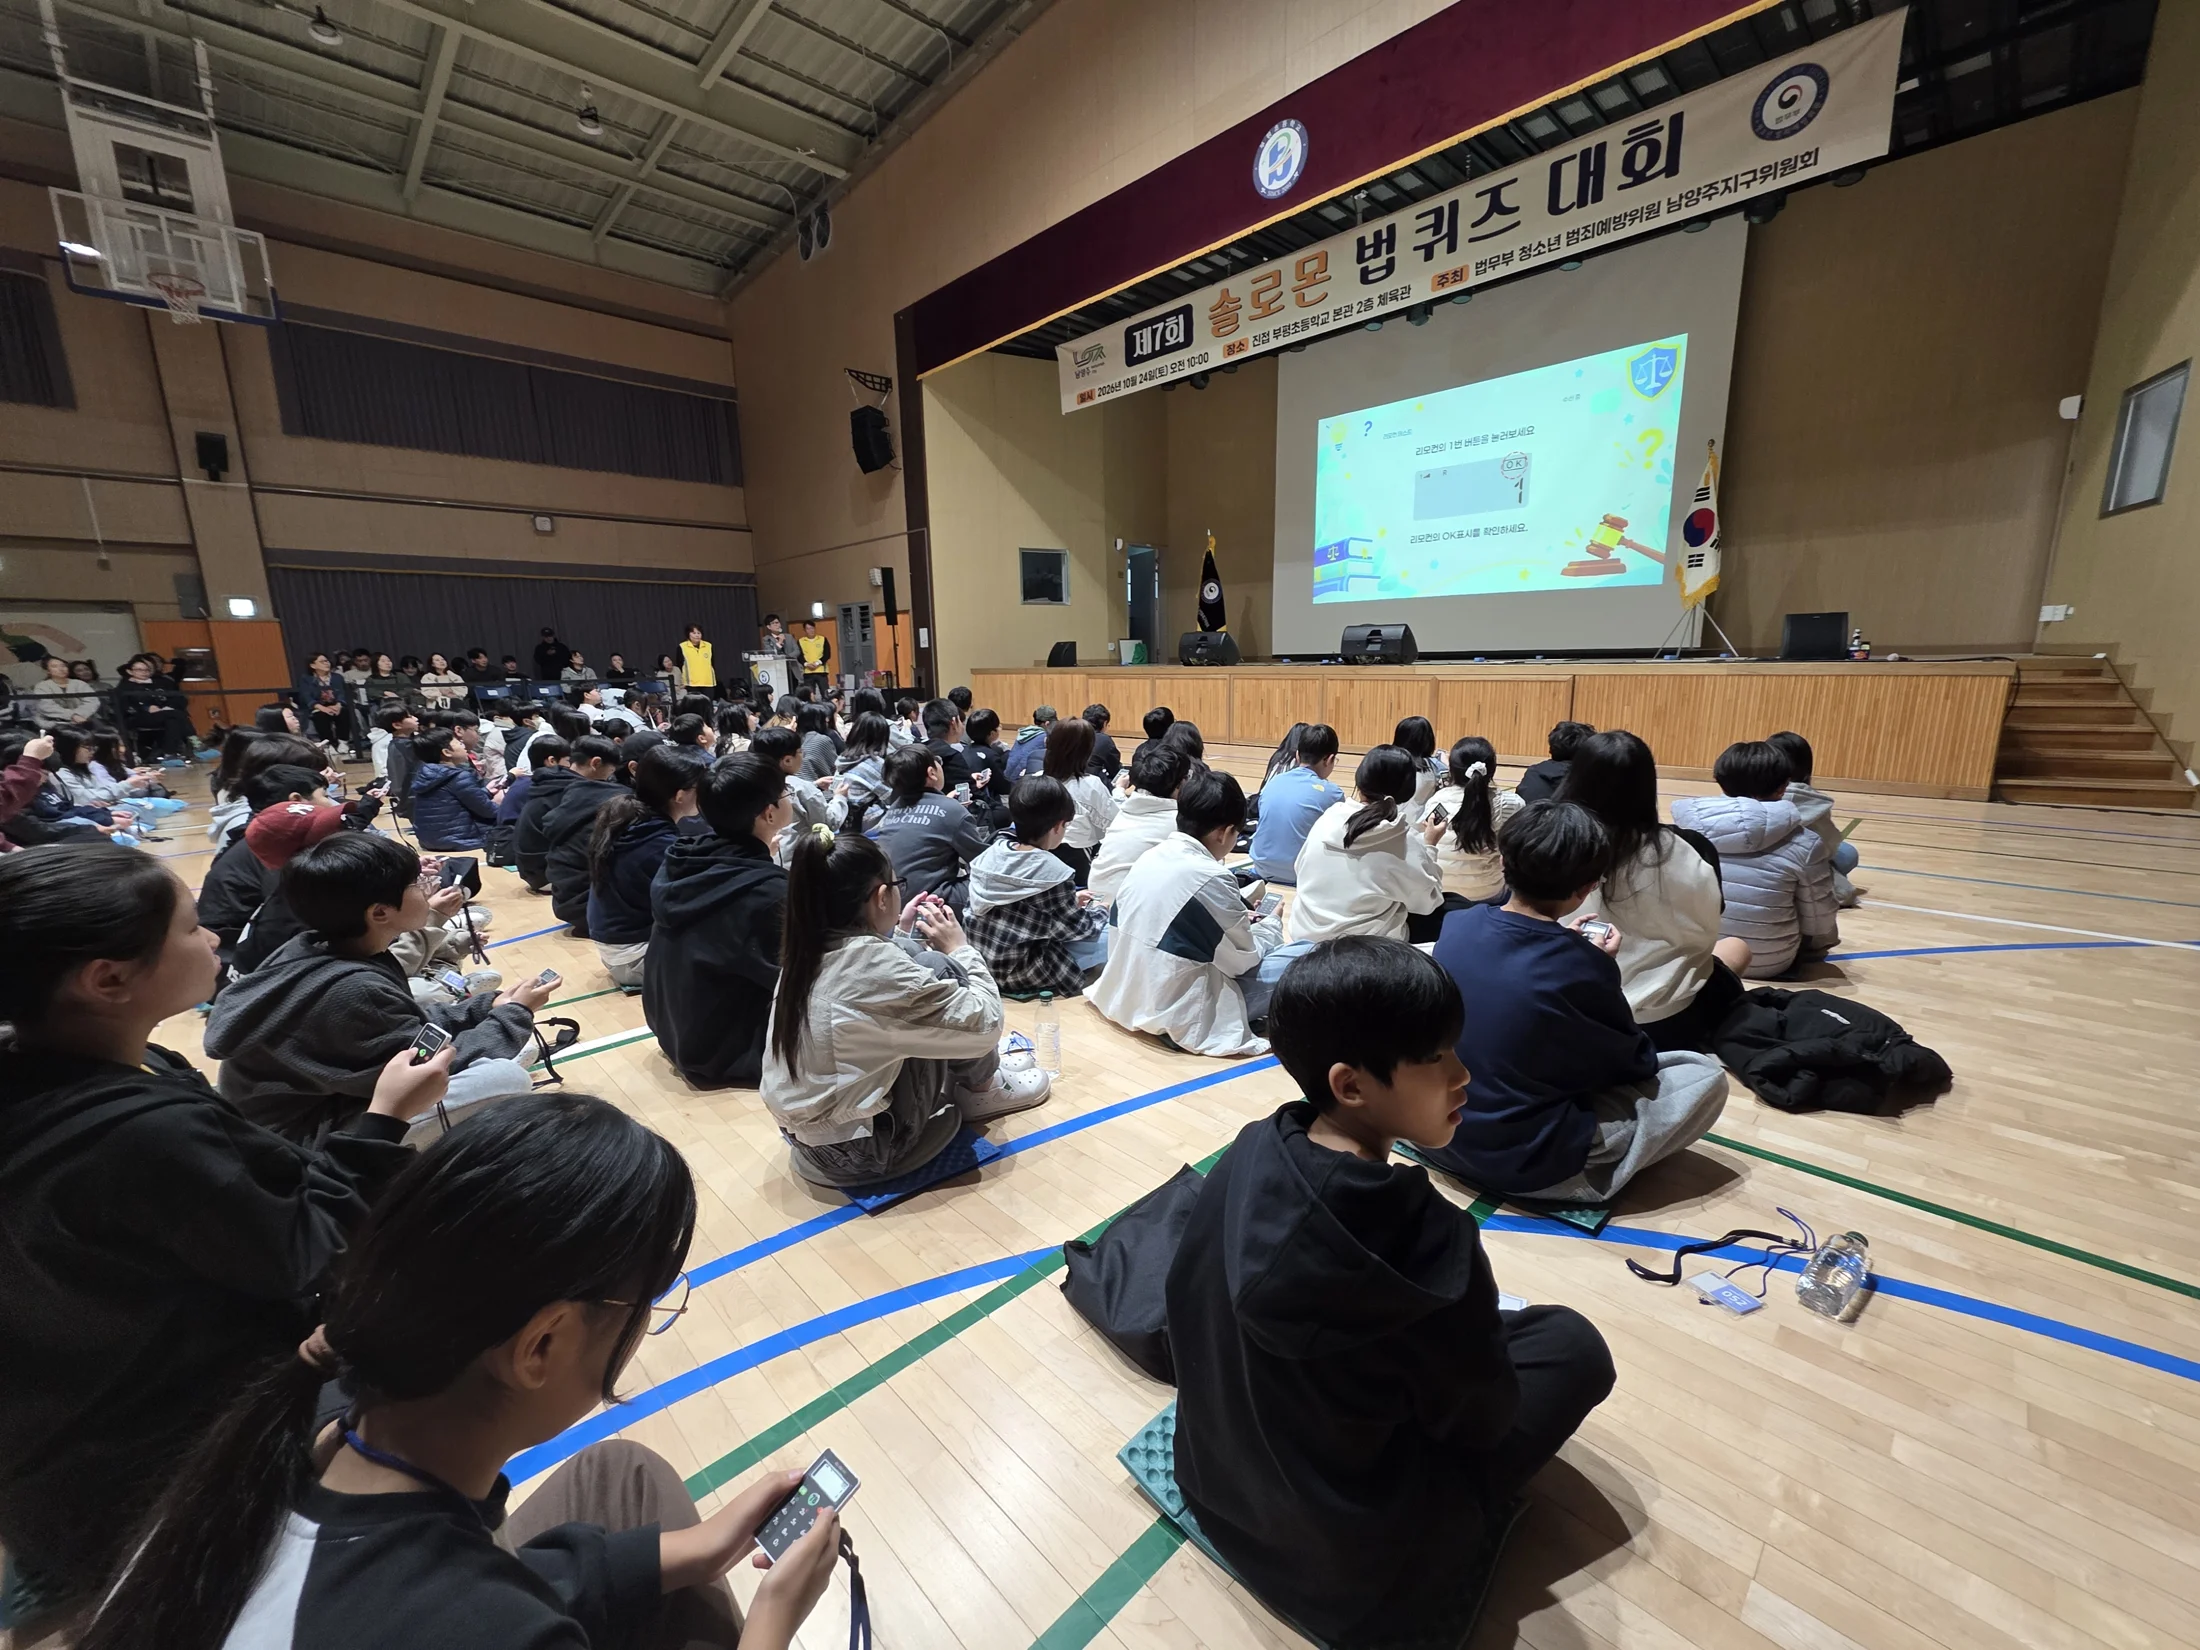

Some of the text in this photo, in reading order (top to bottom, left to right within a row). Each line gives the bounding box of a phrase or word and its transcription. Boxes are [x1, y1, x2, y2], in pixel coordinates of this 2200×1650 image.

[1208, 250, 1332, 338] 솔로몬
[1547, 111, 1684, 216] 대회
[1475, 147, 1820, 276] 법무부 청소년 범죄예방위원 남양주지구위원회
[1436, 268, 1464, 288] 주최
[1252, 284, 1412, 347] 진접 부평초등학교 본관 2층 체육관
[1133, 314, 1185, 358] 제7회
[1226, 342, 1245, 356] 장소
[1098, 352, 1209, 397] 2026년 10월 24일(토) 오전 10:00
[1416, 426, 1535, 456] 리모컨의 1번 버튼을 눌러보세요
[1506, 460, 1522, 469] OK
[1514, 477, 1524, 504] 1
[1410, 533, 1440, 544] 리모컨의
[900, 813, 930, 825] Club
[915, 804, 946, 818] Hills
